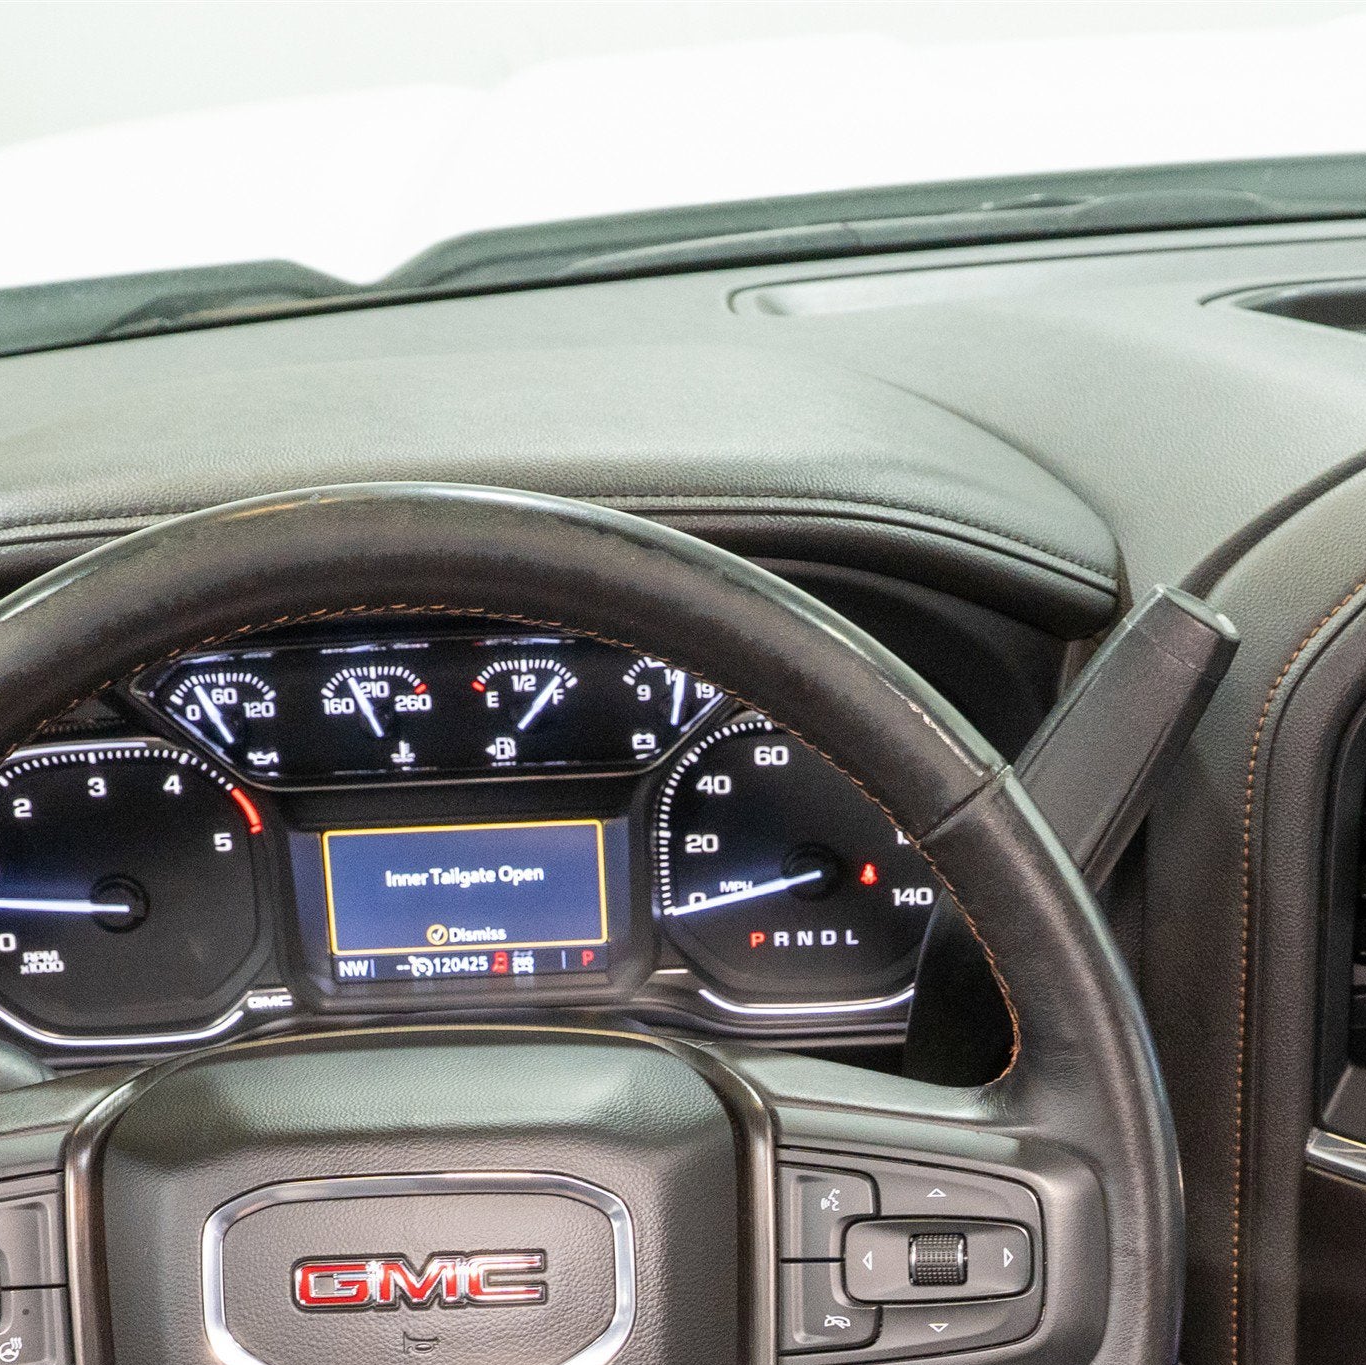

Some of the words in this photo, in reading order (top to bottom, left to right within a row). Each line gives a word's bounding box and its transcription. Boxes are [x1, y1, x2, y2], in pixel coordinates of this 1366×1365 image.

[359, 681, 390, 699] 210
[511, 675, 536, 692] 1/2
[637, 684, 651, 700] 9
[695, 683, 715, 699] 19
[210, 688, 237, 704] 60
[394, 694, 432, 712] 260
[486, 691, 499, 708] E
[552, 688, 565, 704] F
[186, 705, 201, 721] 0
[244, 702, 275, 718] 120
[322, 698, 355, 714] 160
[754, 746, 789, 765] 60
[87, 777, 107, 797] 3
[162, 775, 183, 794] 4
[696, 775, 731, 794] 40
[13, 798, 32, 818] 2
[214, 833, 233, 852] 5
[685, 834, 719, 853] 20
[386, 871, 428, 887] Inner
[430, 867, 496, 888] Tailgate
[498, 865, 544, 885] Open
[720, 881, 753, 893] MPH
[892, 887, 933, 906] 140
[449, 927, 506, 942] Dismiss
[750, 932, 765, 947] P
[774, 931, 789, 946] R
[797, 931, 813, 945] N
[821, 930, 837, 945] D
[846, 930, 859, 945] L
[23, 951, 59, 963] RPM
[339, 960, 369, 977] NW
[433, 956, 488, 973] 120425
[248, 996, 293, 1008] GMC
[296, 1254, 544, 1306] GMC
